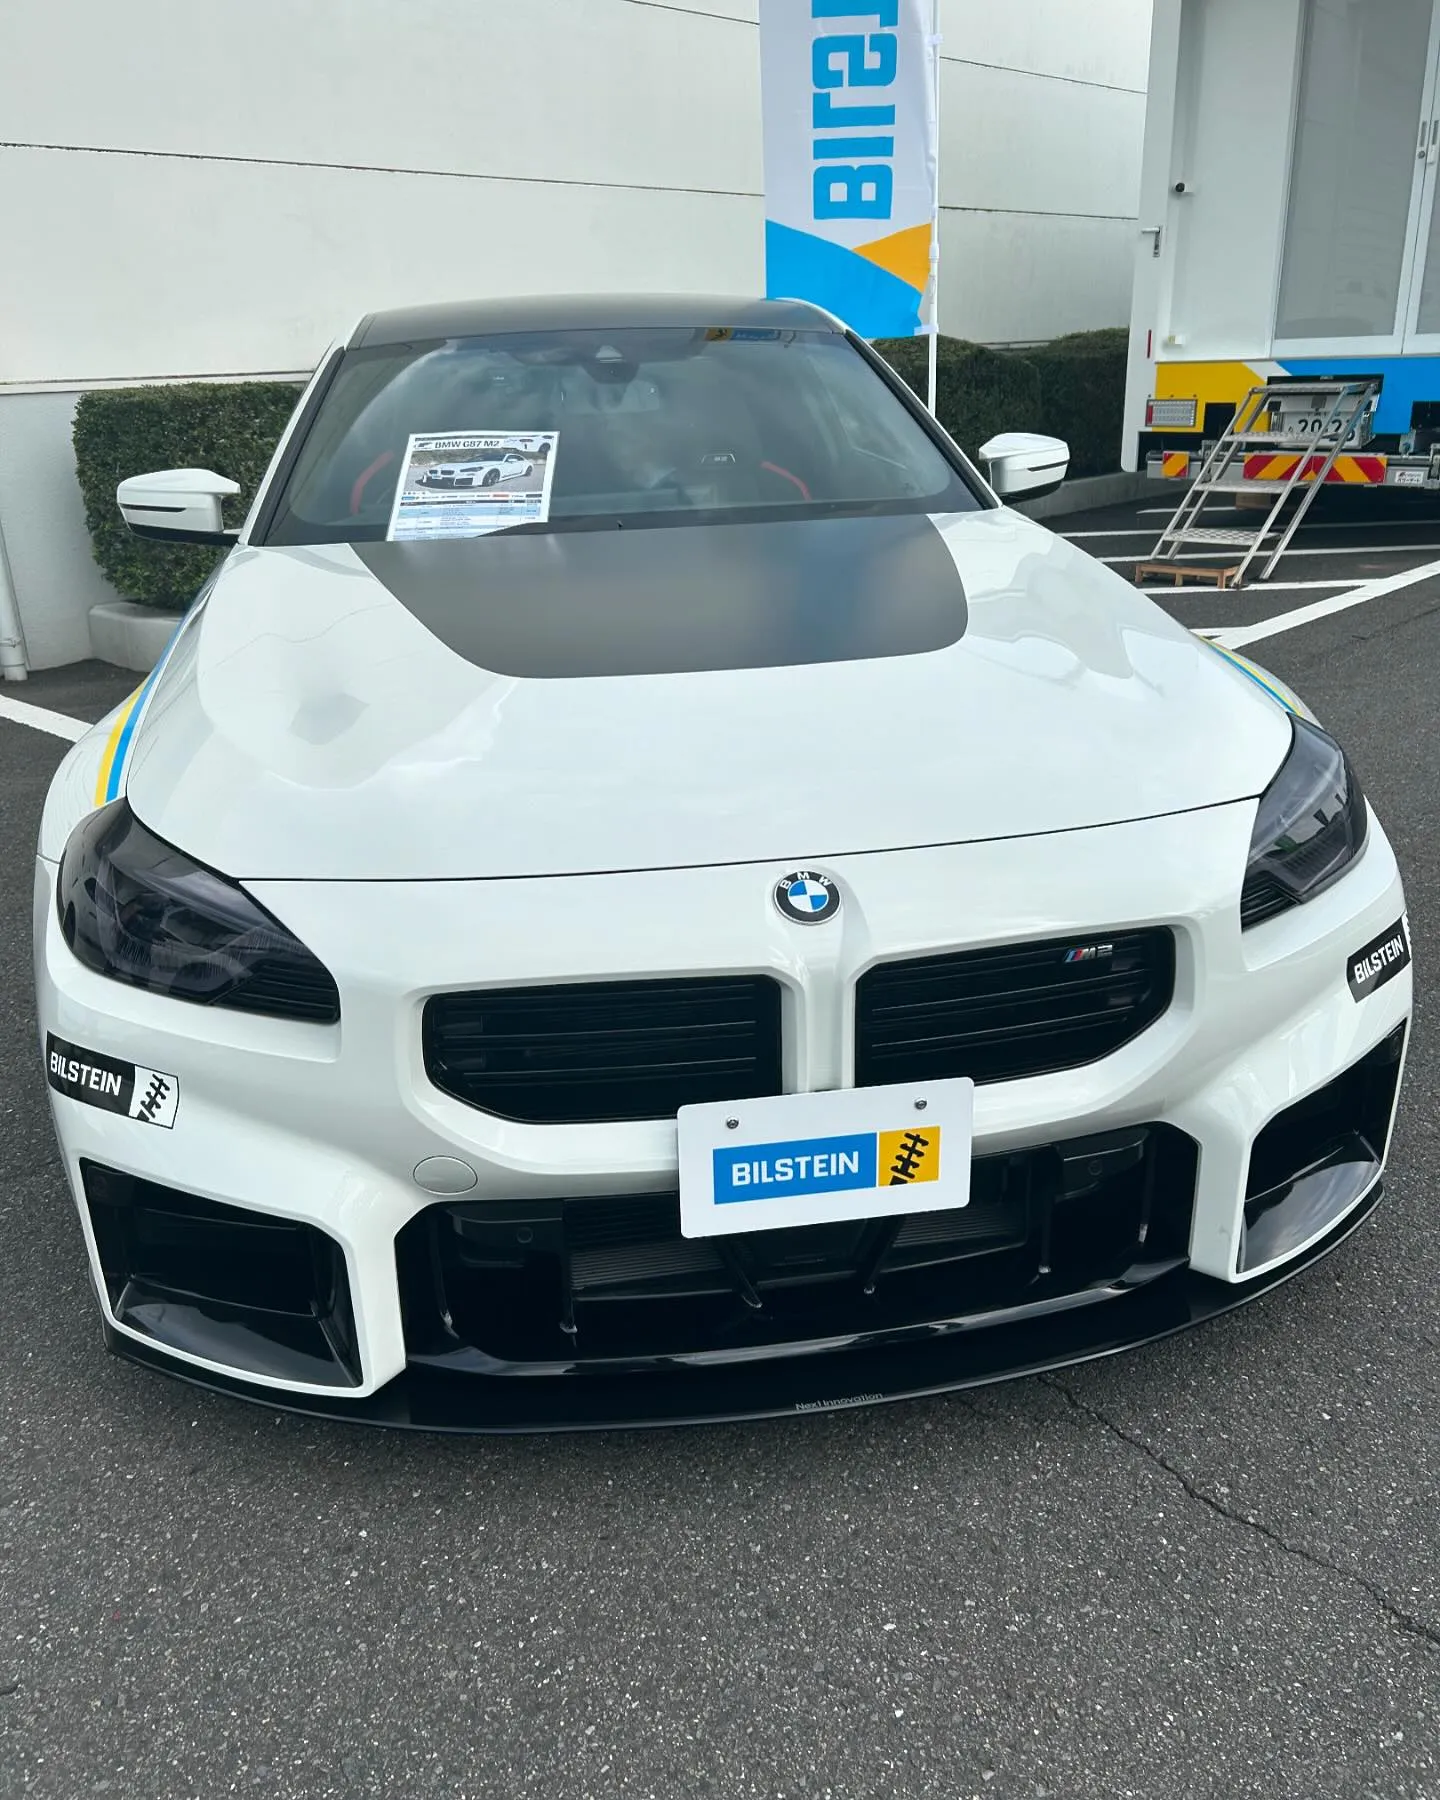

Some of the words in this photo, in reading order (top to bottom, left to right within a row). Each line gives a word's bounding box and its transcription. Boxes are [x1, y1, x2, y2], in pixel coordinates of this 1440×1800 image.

[435, 440, 462, 449] BMW
[483, 440, 500, 448] M2
[780, 872, 832, 890] BMW
[1354, 934, 1404, 984] BILSTEIN
[50, 1051, 122, 1096] BILSTEIN
[732, 1151, 859, 1187] BILSTEIN
[795, 1400, 822, 1410] Next
[823, 1393, 883, 1407] Innovation
